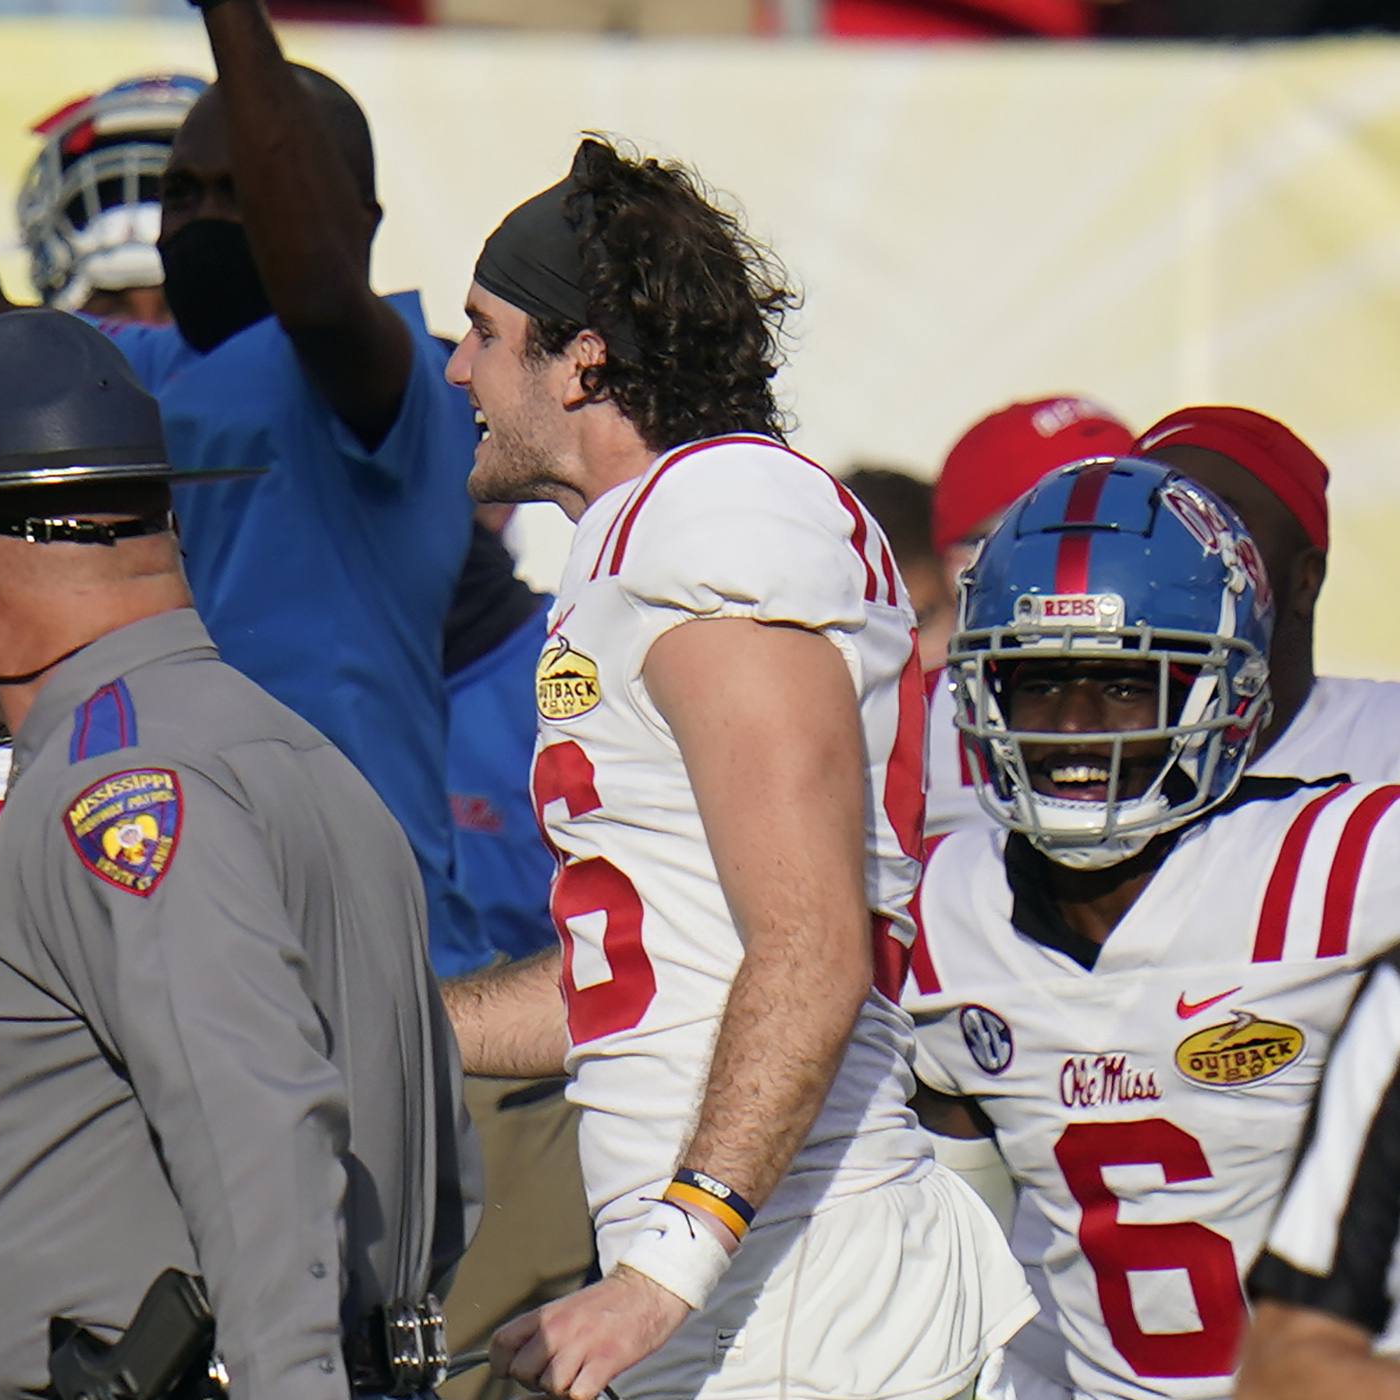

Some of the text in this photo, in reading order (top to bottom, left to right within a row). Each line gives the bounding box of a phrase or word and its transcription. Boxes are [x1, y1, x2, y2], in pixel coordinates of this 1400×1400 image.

[1043, 599, 1096, 617] REBS
[69, 774, 174, 827] MISSISSIPPI
[1060, 1055, 1163, 1109] Ole Miss
[1189, 1042, 1292, 1071] OUTBACK
[1053, 1118, 1251, 1378] 6
